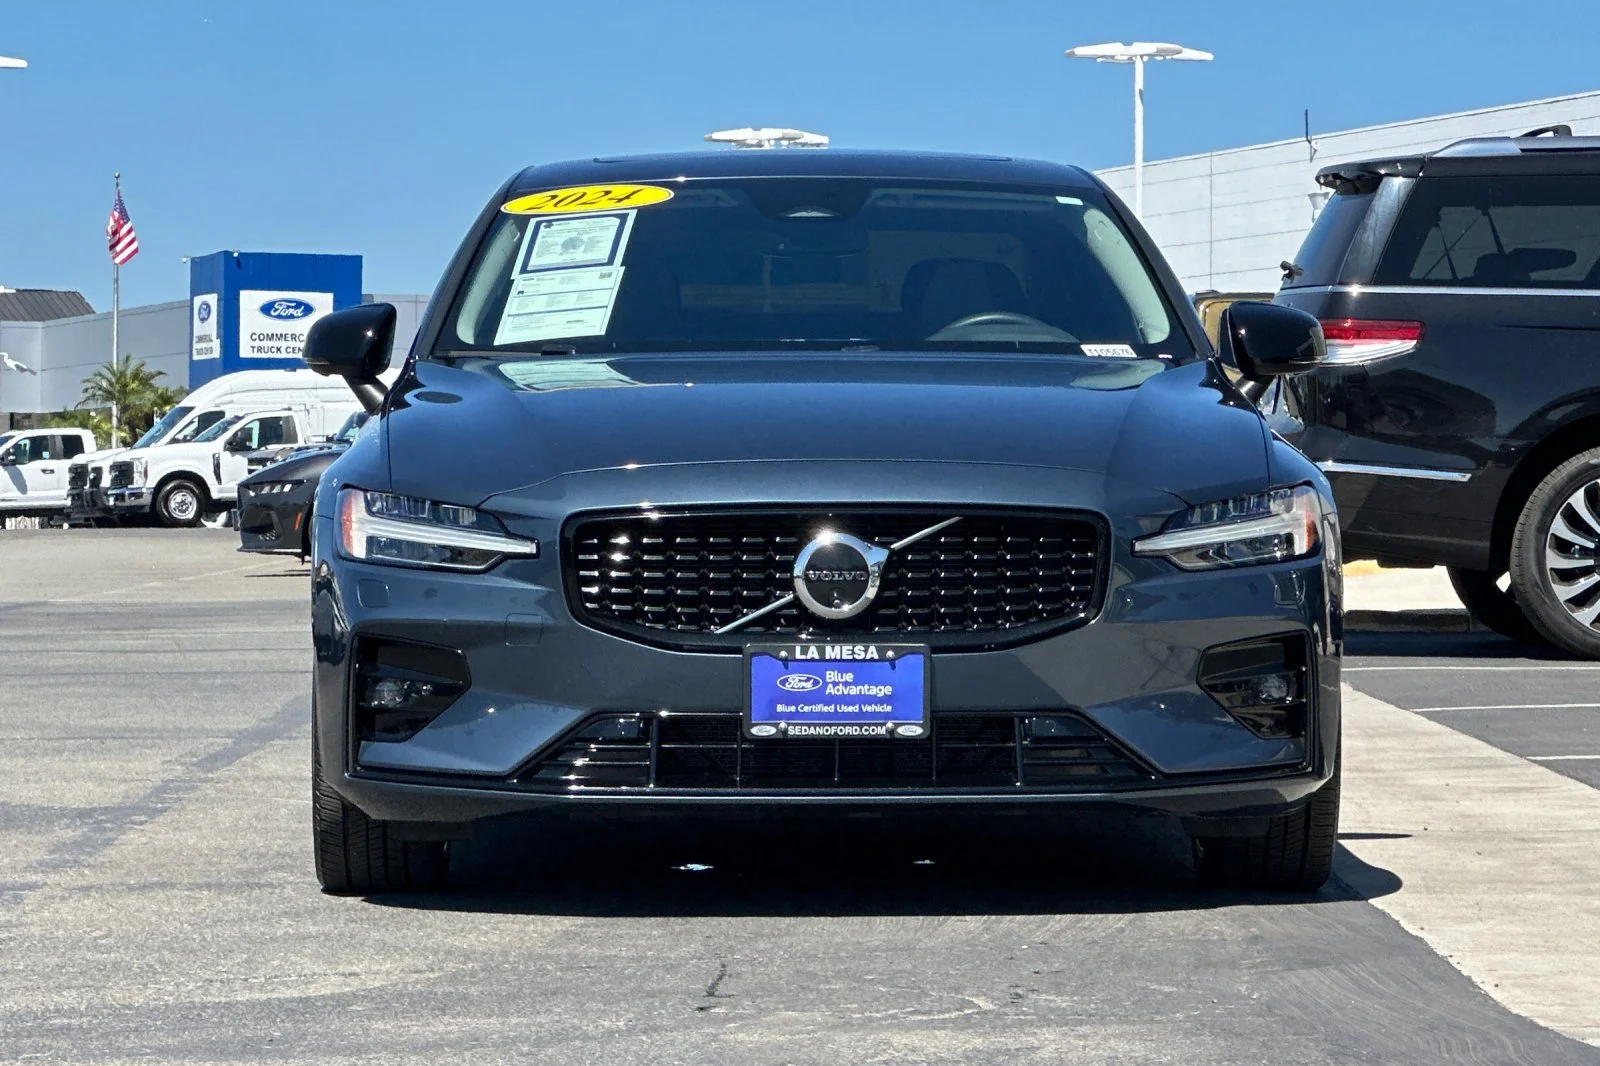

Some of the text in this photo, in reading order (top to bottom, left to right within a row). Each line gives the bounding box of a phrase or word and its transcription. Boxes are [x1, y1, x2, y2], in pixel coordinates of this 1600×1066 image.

[521, 187, 646, 211] 2024
[270, 301, 304, 317] Ford
[250, 332, 305, 342] COMMERC
[250, 345, 305, 354] TRUCK CEN
[806, 570, 868, 580] VOLVO
[795, 645, 879, 660] LA MESA
[785, 676, 814, 690] Ford
[825, 670, 854, 683] Blue
[825, 683, 892, 697] Advantage
[776, 703, 892, 713] Blue Certified Used Vehicle
[788, 725, 886, 736] SEDANOFORD.COM
